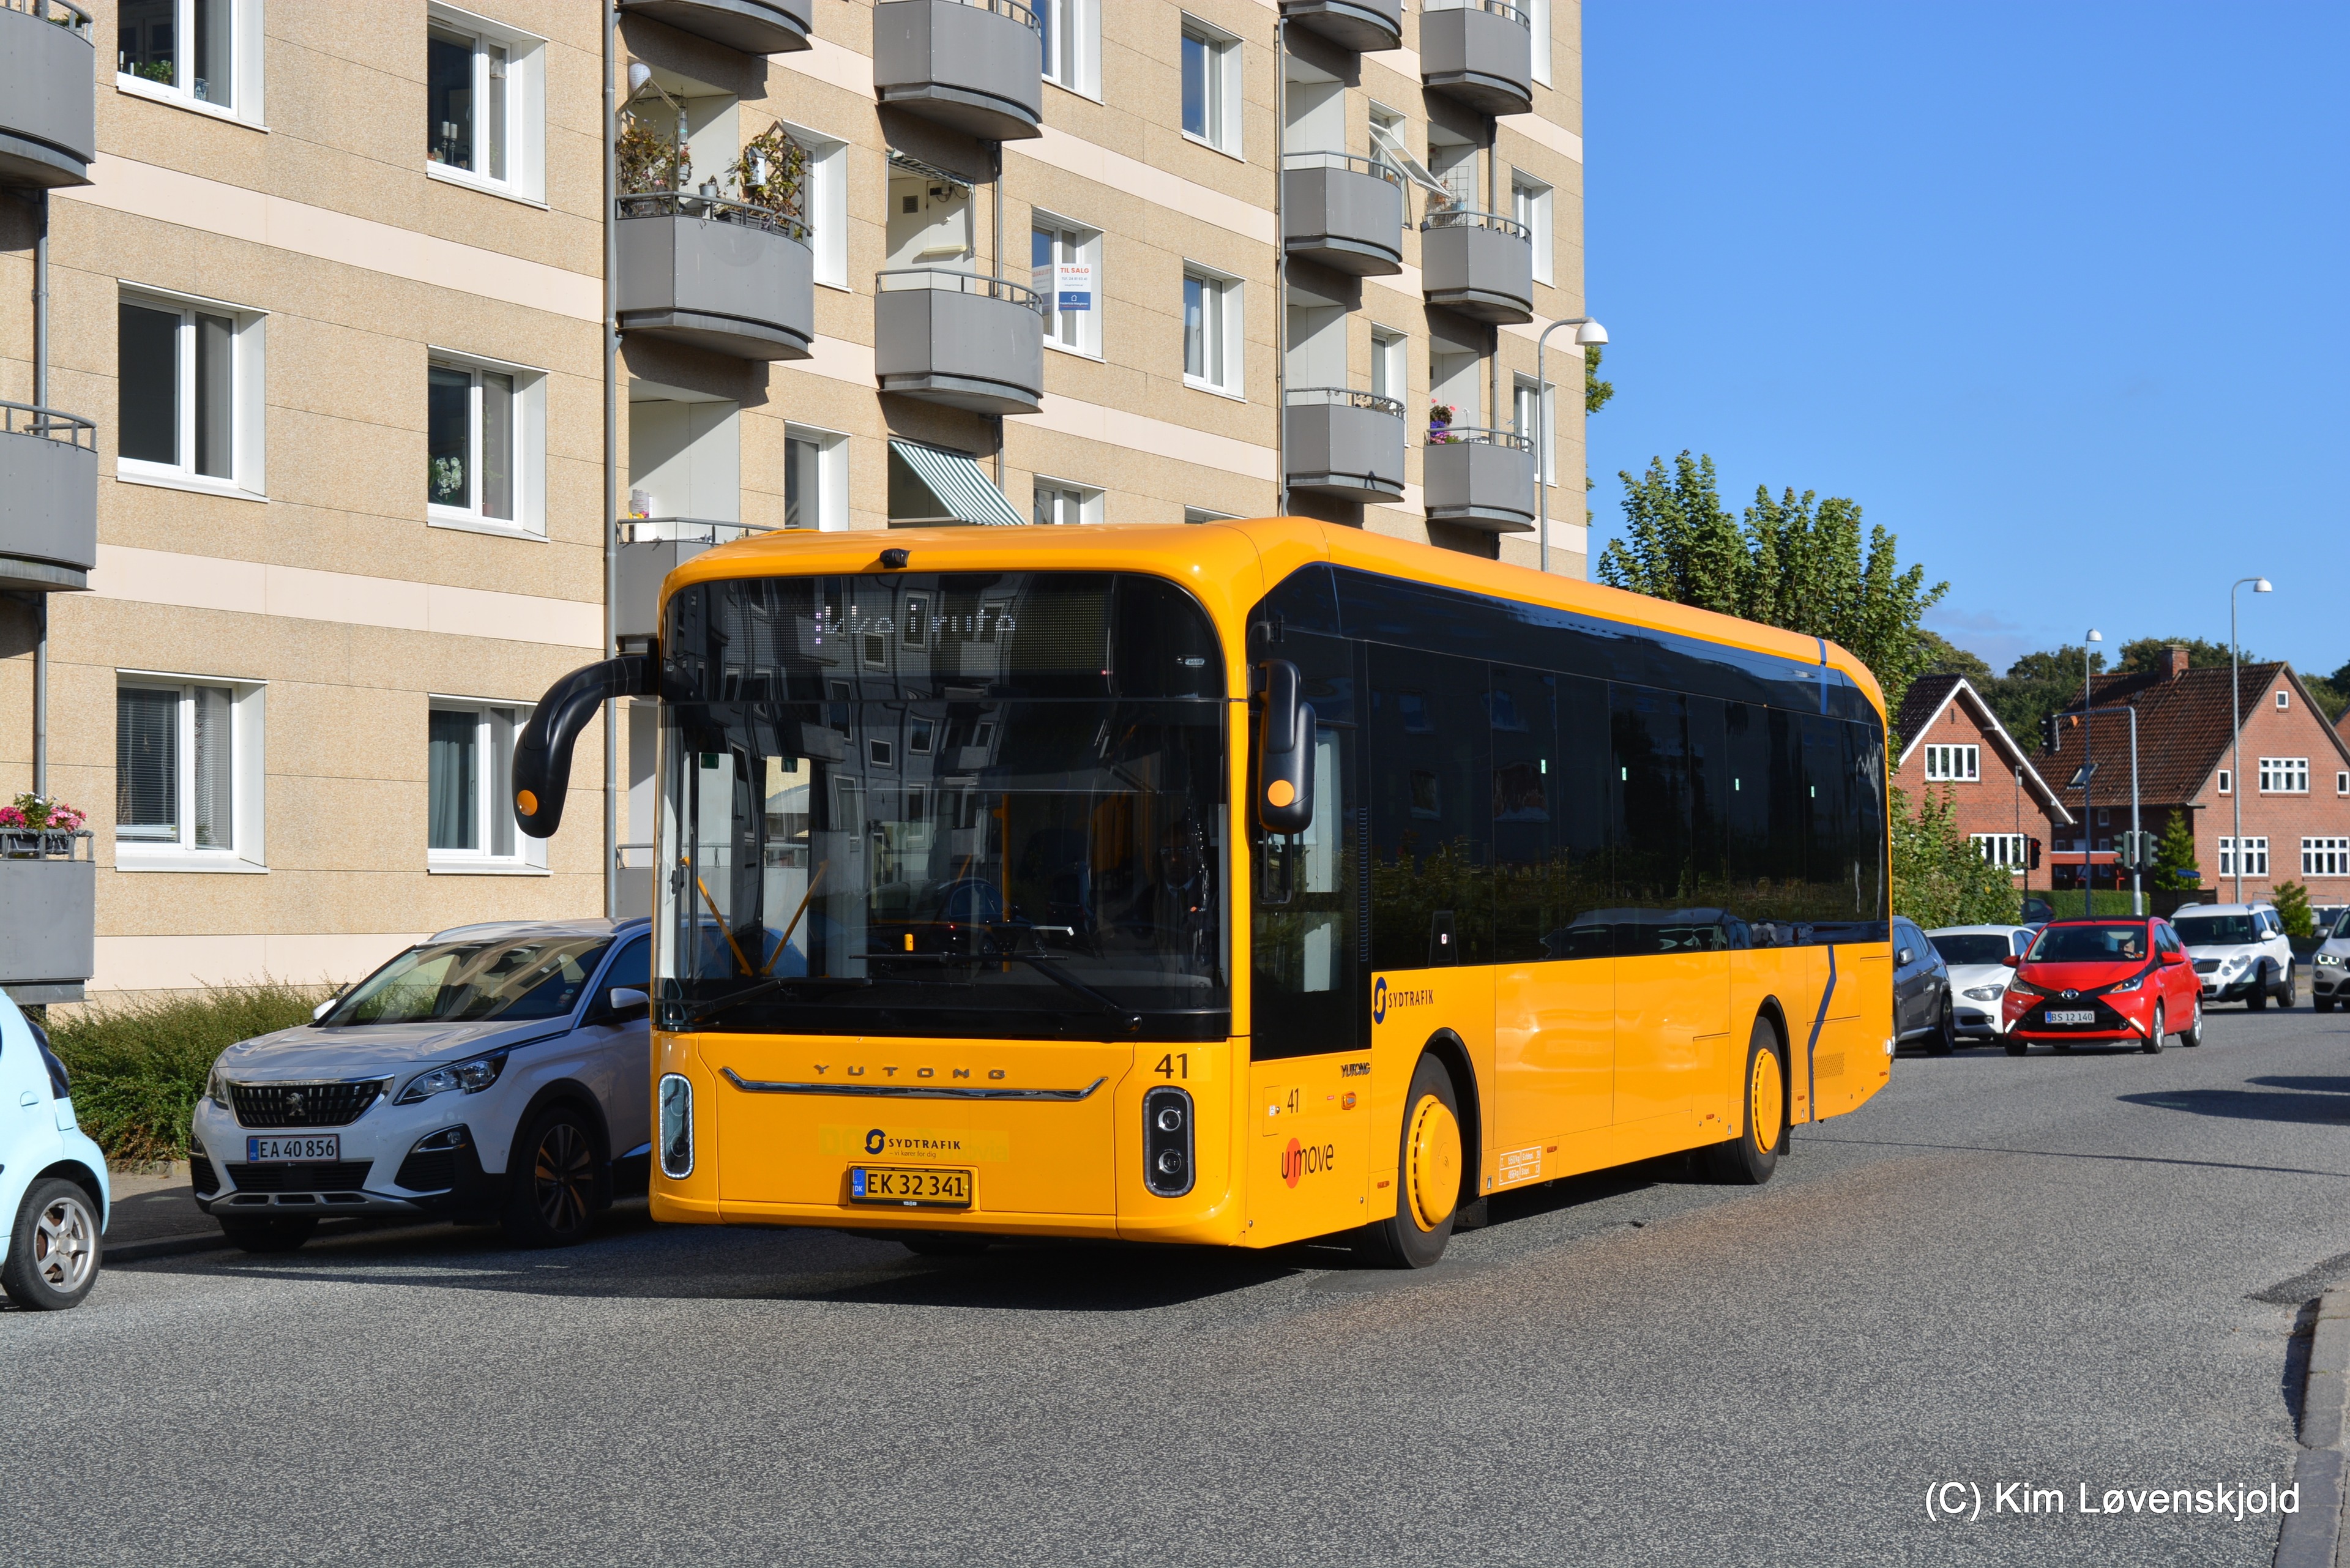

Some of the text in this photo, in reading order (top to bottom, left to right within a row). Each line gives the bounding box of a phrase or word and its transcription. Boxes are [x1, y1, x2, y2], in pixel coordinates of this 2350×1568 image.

[1389, 989, 1433, 1009] SYDTRAFIK
[2051, 1013, 2063, 1021] BS
[2065, 1013, 2075, 1021] 12
[2078, 1013, 2093, 1021] 140
[814, 1064, 1005, 1080] YUTONG
[1154, 1053, 1188, 1080] 41
[1341, 1062, 1371, 1078] YUTONG
[1287, 1087, 1299, 1114] 41
[259, 1140, 335, 1158] EA 40 856
[889, 1138, 961, 1150] SYDTRAFIK
[867, 1173, 964, 1197] EK 32 341
